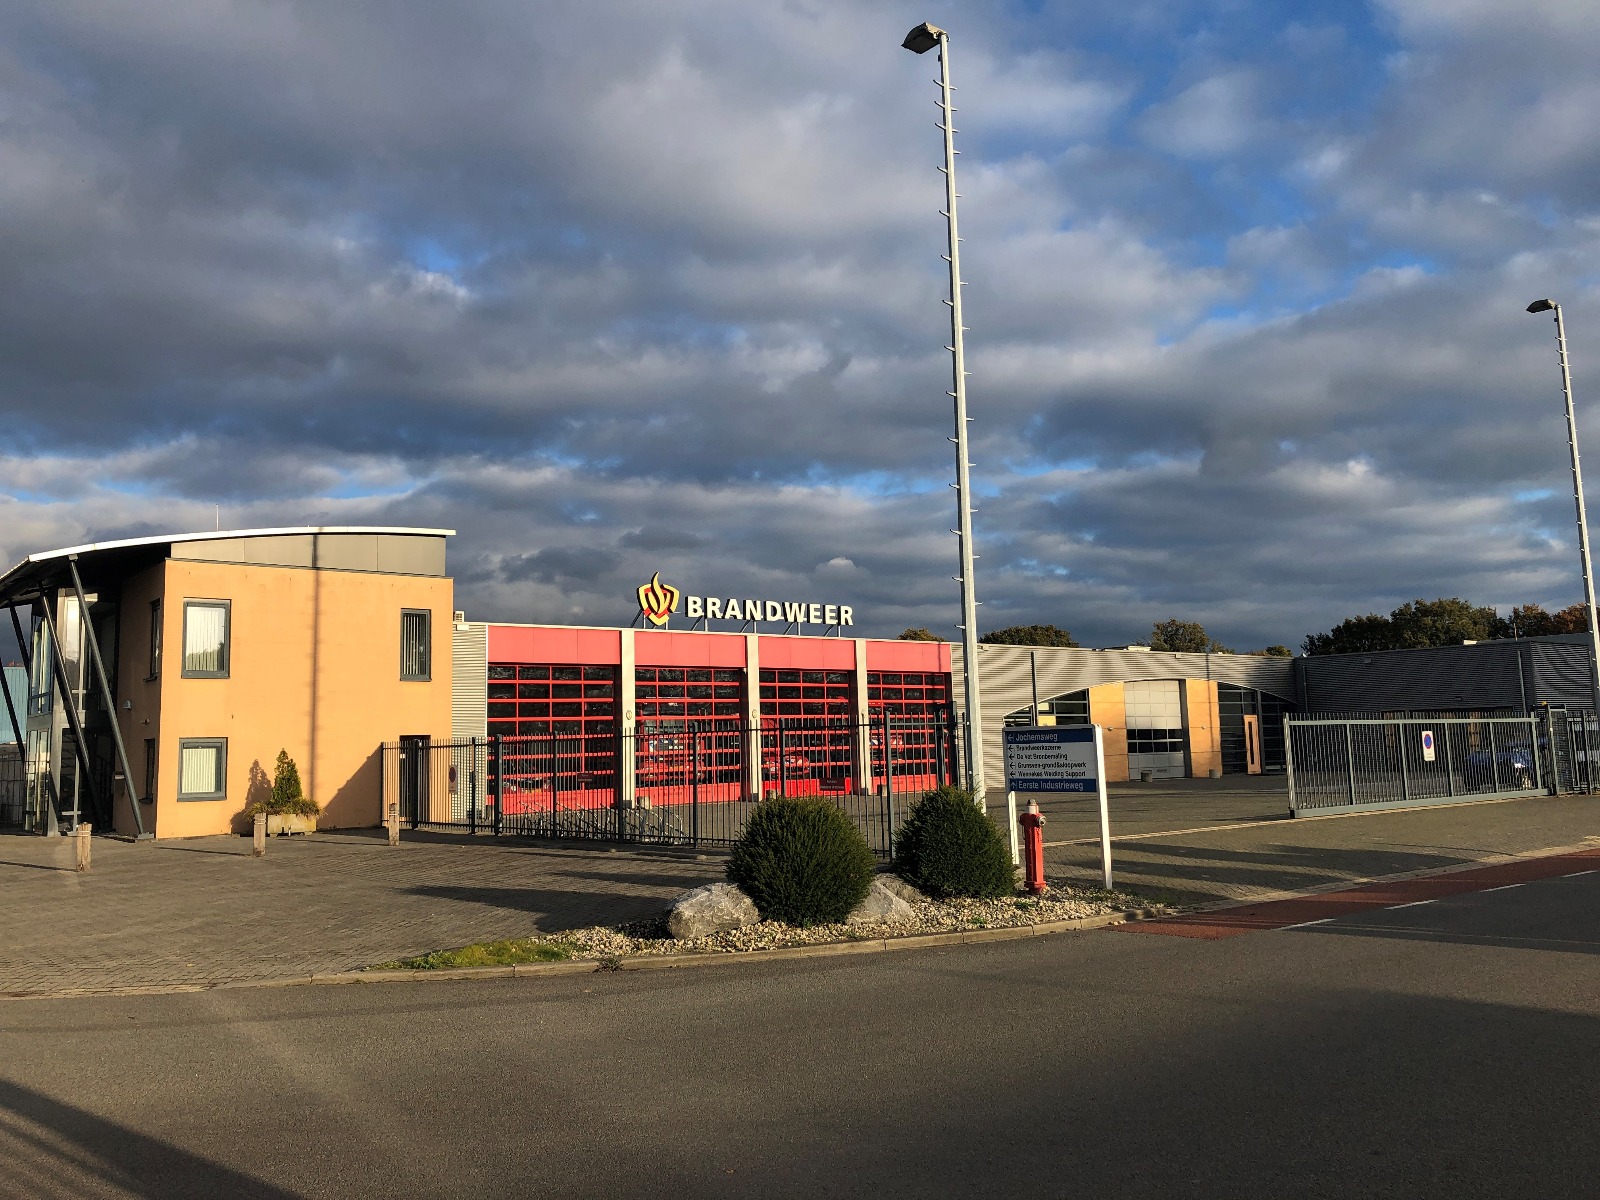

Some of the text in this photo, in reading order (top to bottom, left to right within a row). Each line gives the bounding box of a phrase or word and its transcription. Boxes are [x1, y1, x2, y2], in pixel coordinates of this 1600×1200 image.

[685, 596, 853, 625] BRANDWEER
[1016, 733, 1058, 742] Jochemsweg
[1019, 780, 1084, 791] Eerste Industrieweg
